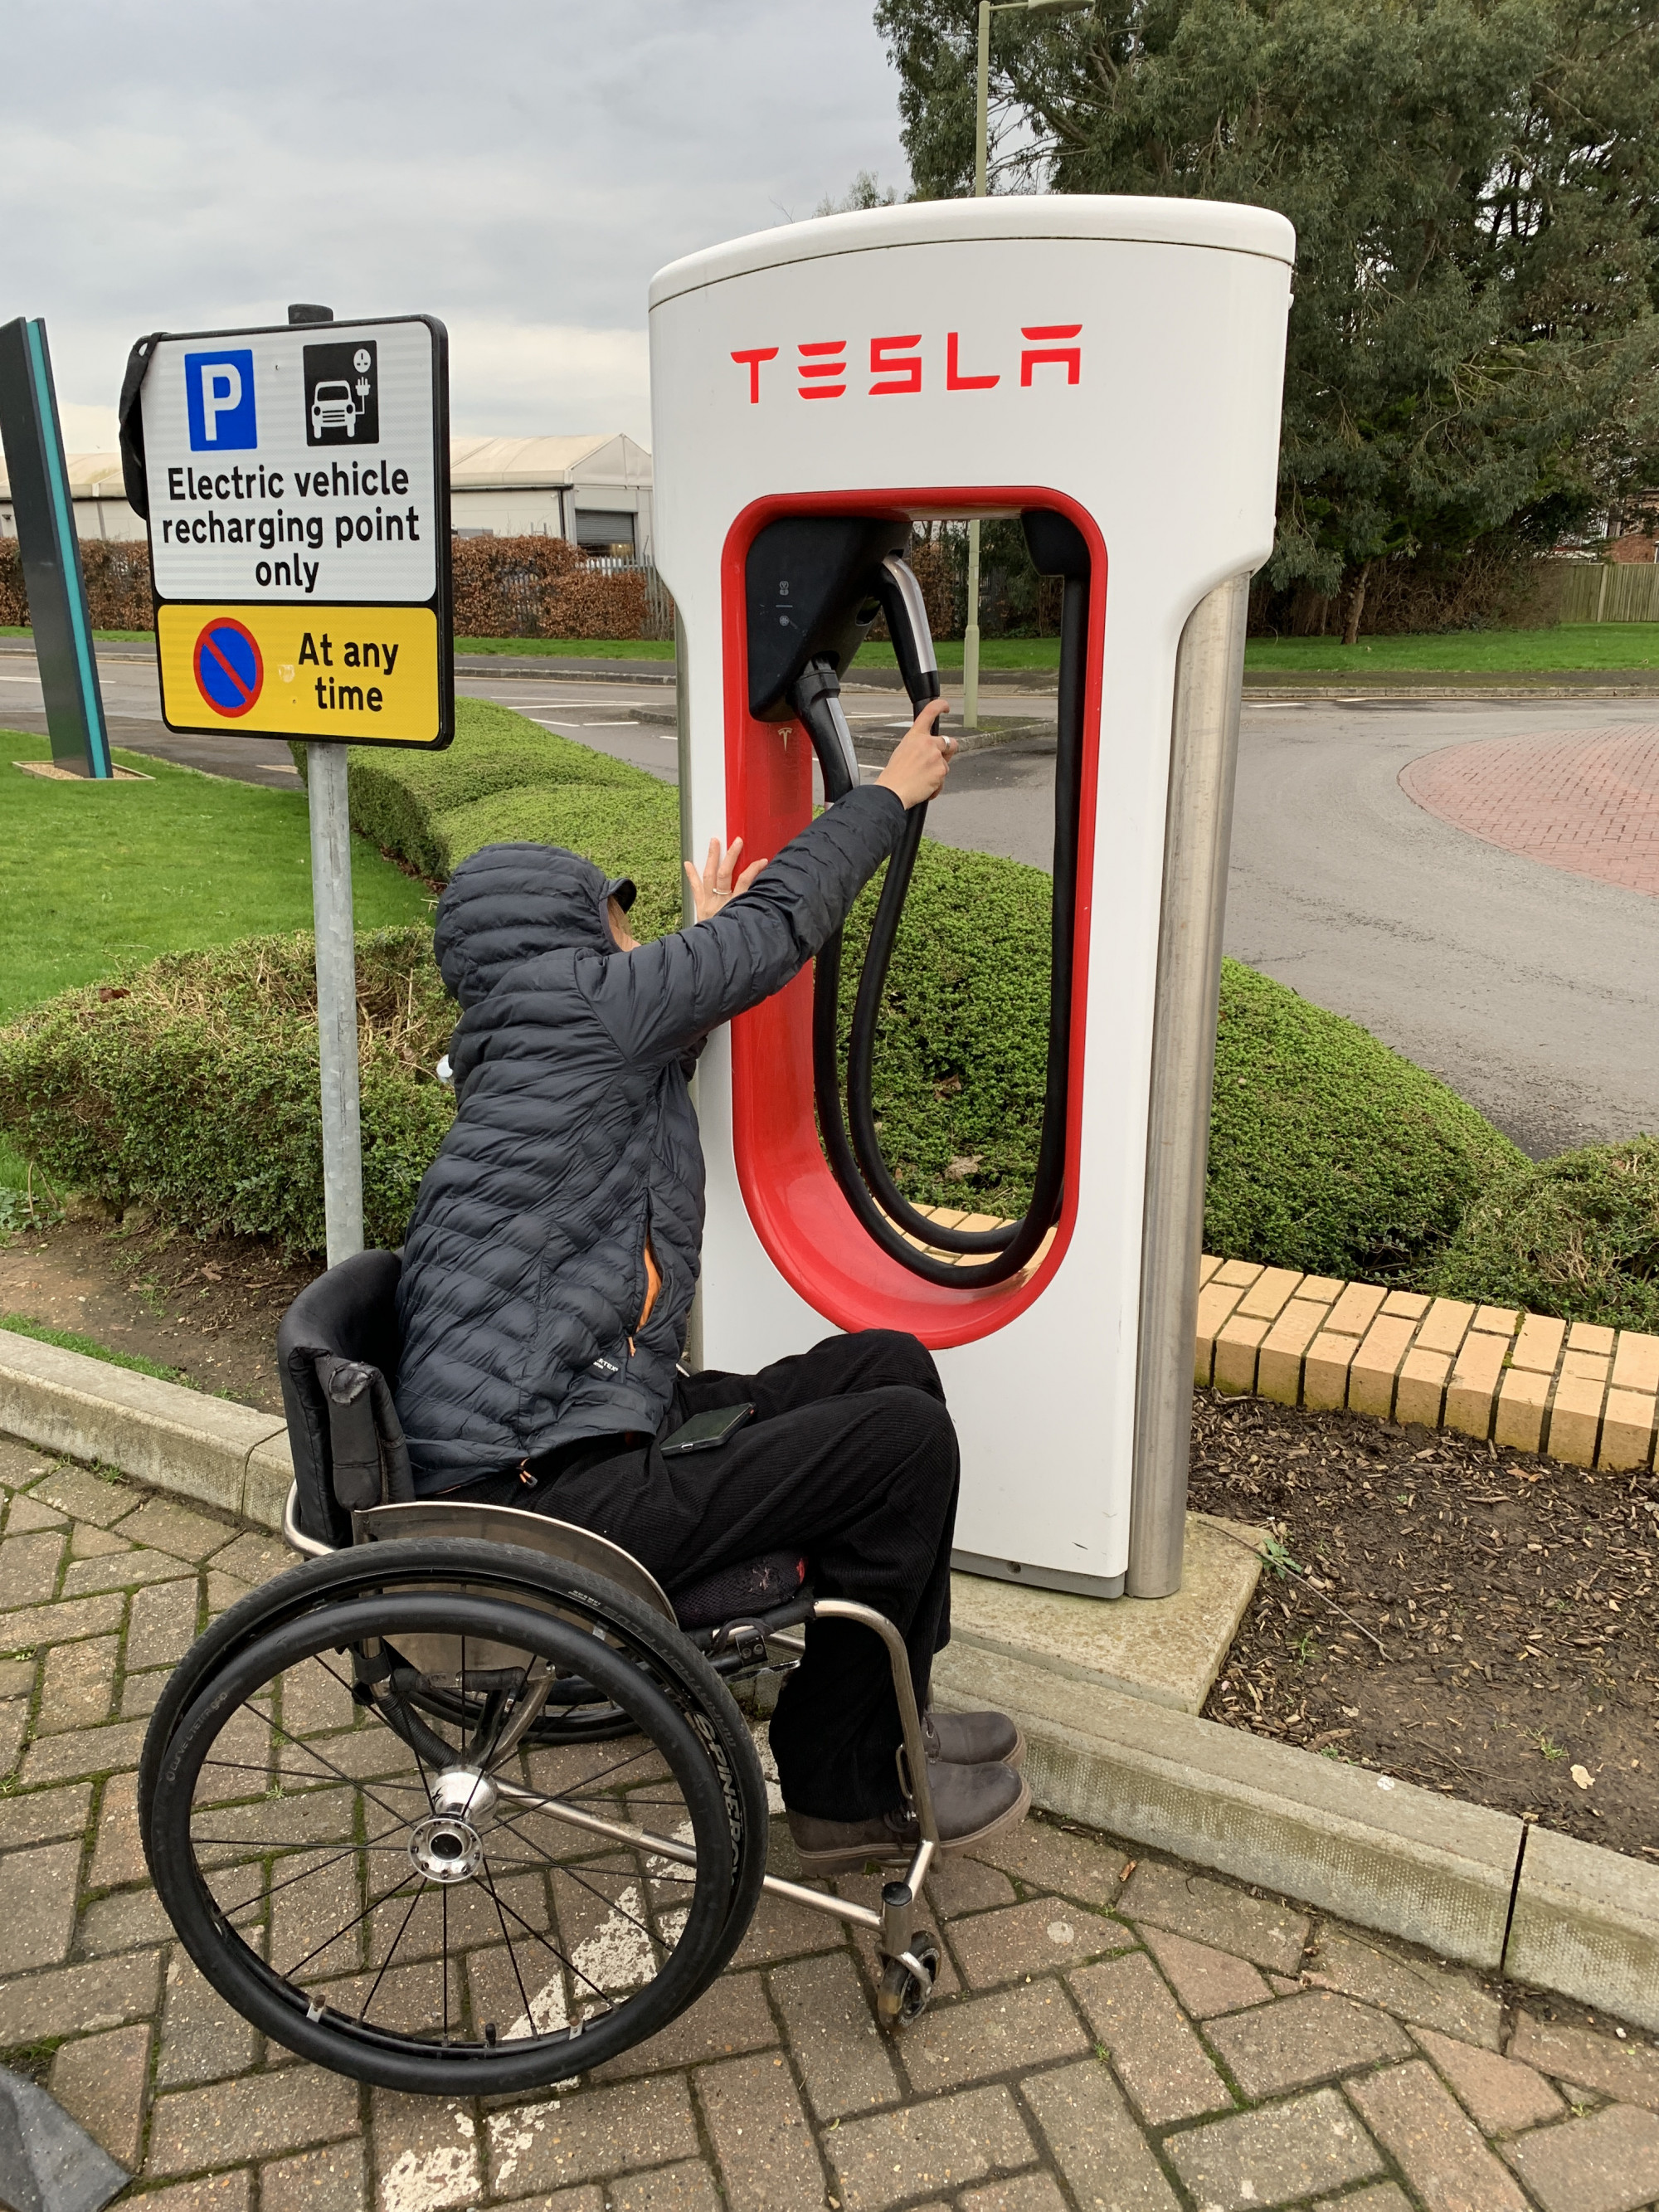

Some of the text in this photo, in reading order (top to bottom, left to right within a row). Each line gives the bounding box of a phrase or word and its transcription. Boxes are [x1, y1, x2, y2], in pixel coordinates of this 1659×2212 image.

[730, 324, 1082, 404] TESLA
[201, 363, 242, 441] P
[168, 460, 409, 500] Electric vehicle
[163, 505, 421, 550] recharging point
[255, 553, 319, 593] only
[298, 632, 399, 676] At any
[314, 676, 383, 713] time
